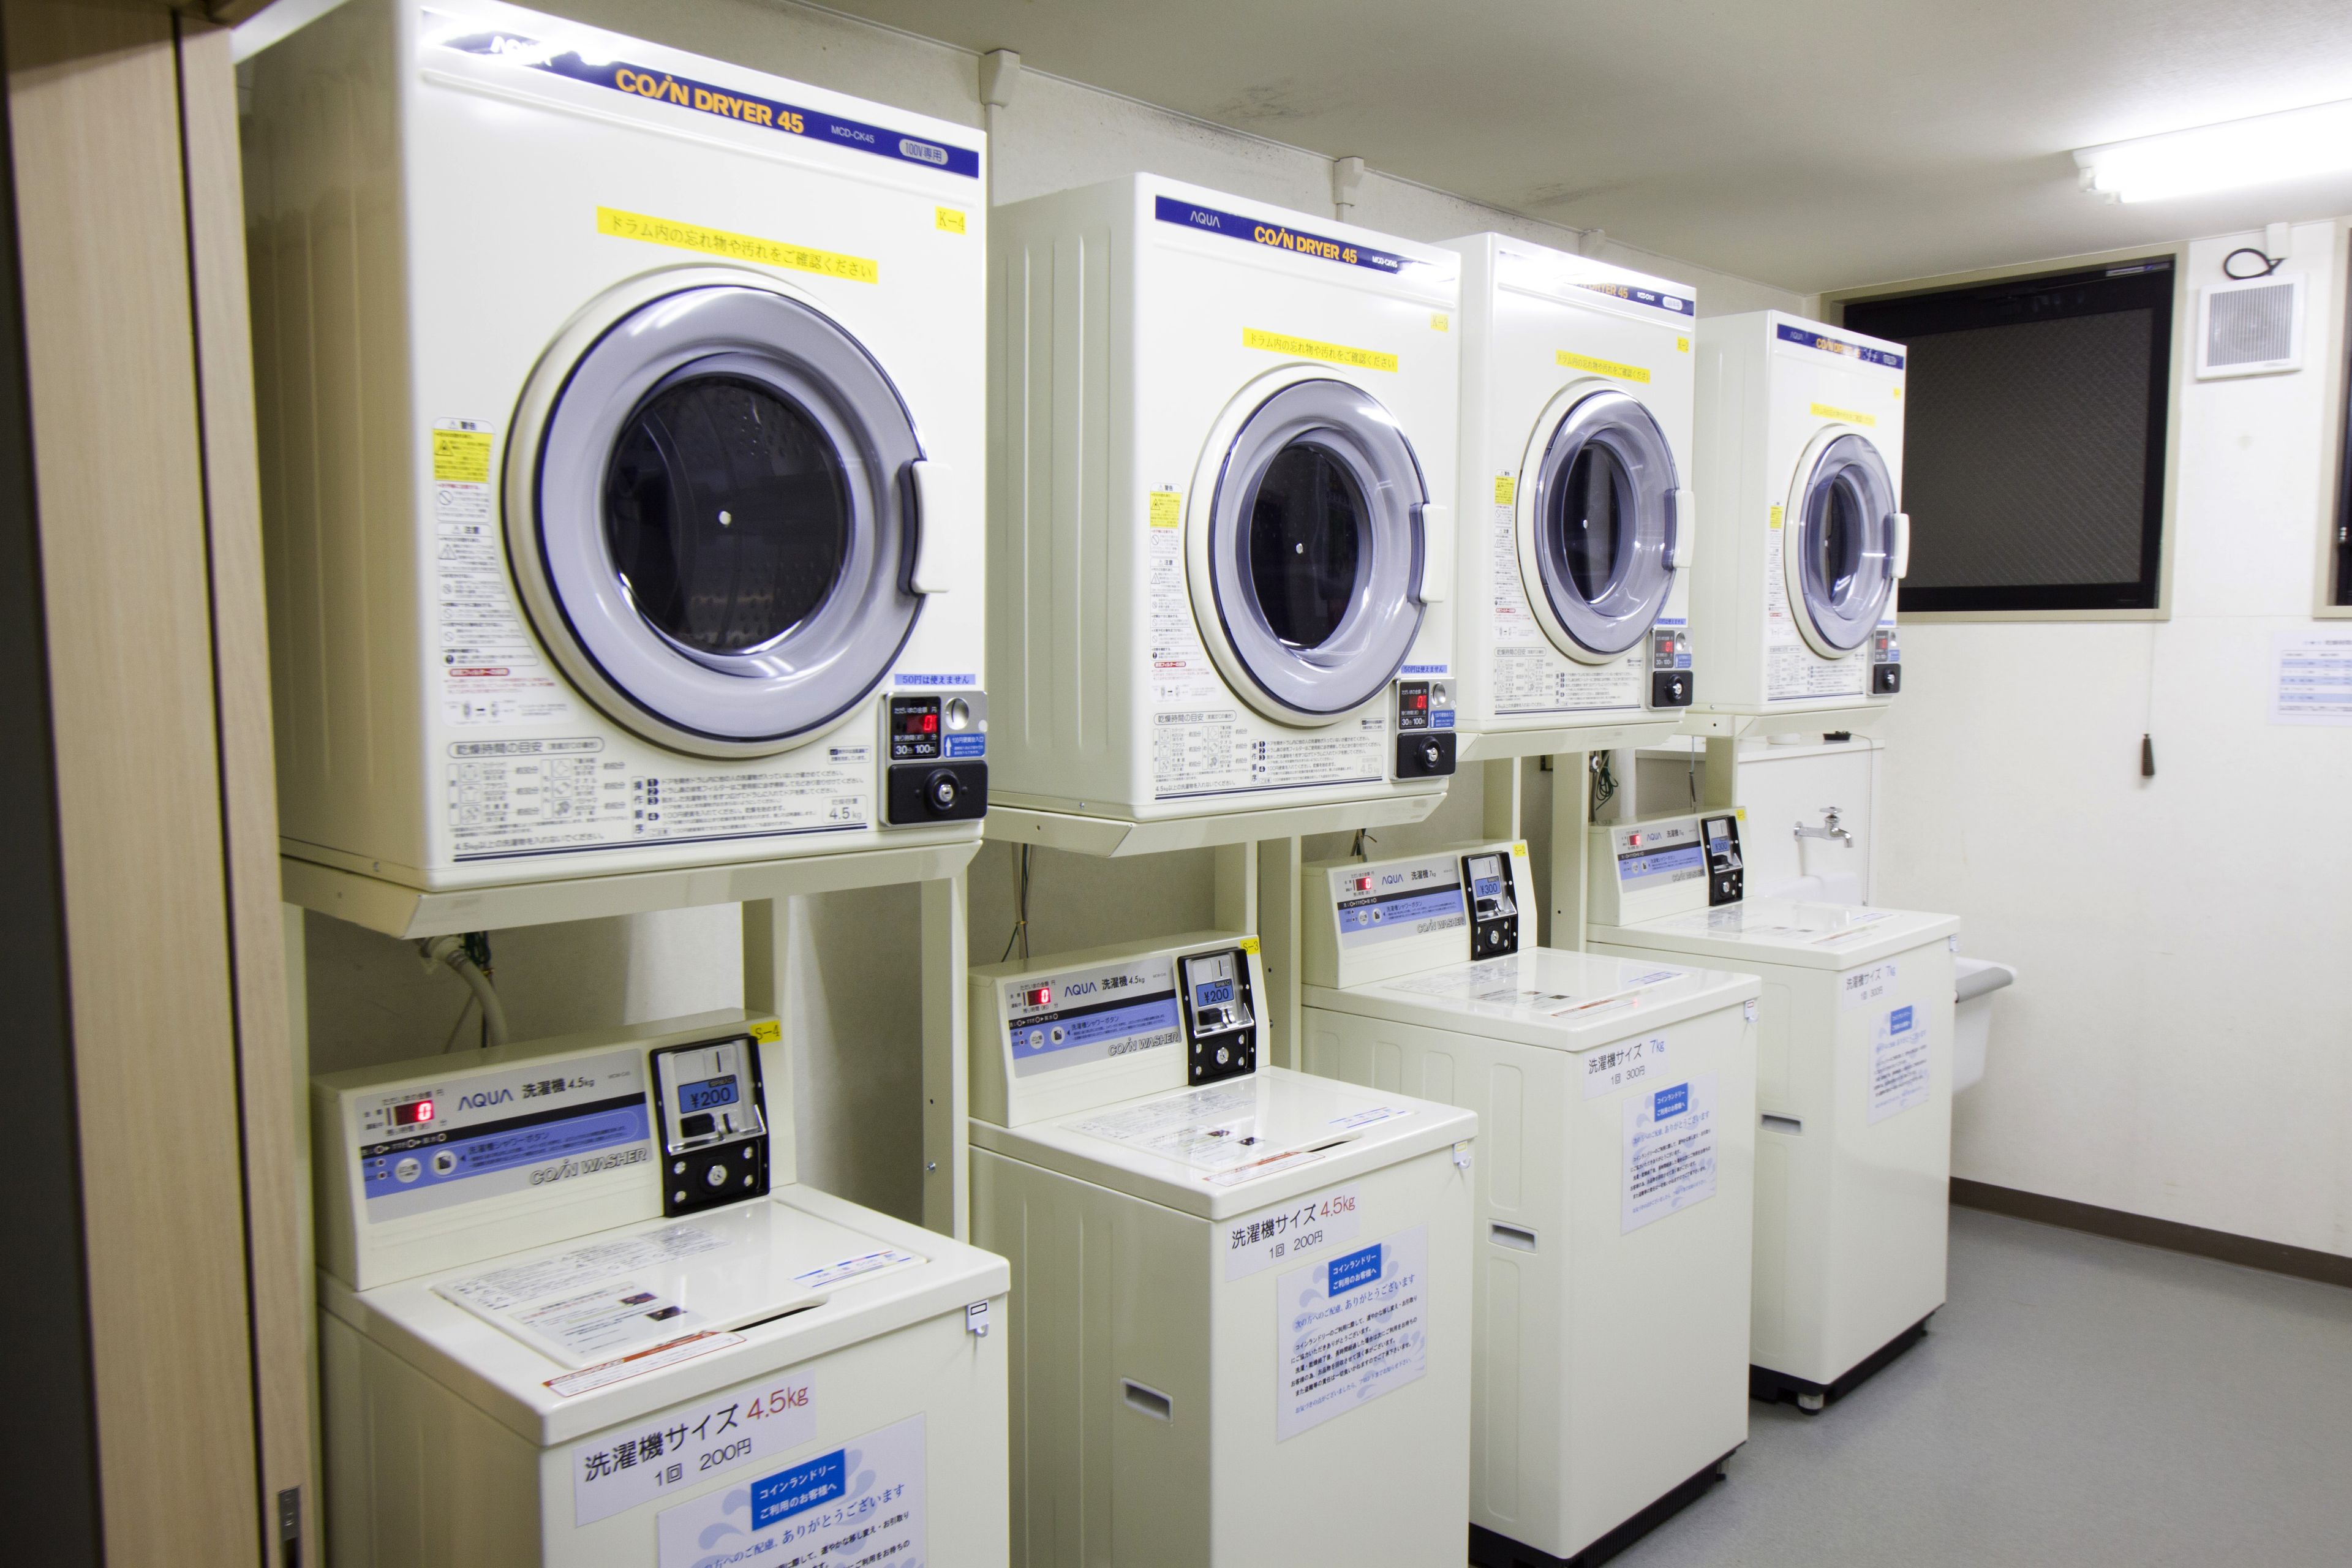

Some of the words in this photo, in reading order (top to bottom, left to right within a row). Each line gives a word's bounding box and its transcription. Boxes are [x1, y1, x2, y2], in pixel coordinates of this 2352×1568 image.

[694, 90, 772, 127] DRYER
[777, 111, 804, 134] 45
[831, 125, 875, 144] MCD-CK45
[905, 142, 942, 162] 100V専用
[612, 214, 872, 277] ドラム内の忘れ物や汚れをご確認ください
[1190, 211, 1220, 228] AQUA
[1297, 236, 1340, 260] DRYER
[1342, 248, 1357, 264] 45
[1618, 287, 1628, 298] 45
[1250, 334, 1395, 369] ドラム内の忘れ物や汚れをご確認ください
[903, 675, 970, 685] 50円は使えません
[1158, 714, 1204, 723] 乾燥時間の目安
[456, 742, 543, 755] 乾燥時間の目安
[1382, 874, 1403, 885] AQUA
[1411, 870, 1428, 880] 洗濯機
[1041, 989, 1049, 1003] 0
[1064, 982, 1097, 997] AQUA
[1102, 976, 1128, 990] 洗濯機
[1129, 975, 1145, 984] 4.5kg
[1204, 988, 1229, 1003] ¥200
[755, 1024, 780, 1040] S-4
[1138, 1032, 1178, 1050] WASHER
[1589, 1043, 1642, 1074] 洗濯機サイズ
[1650, 1039, 1665, 1054] 7kg
[1611, 1074, 1621, 1085] 1回
[1626, 1065, 1645, 1080] 300円
[457, 1088, 514, 1111] AQUA
[522, 1078, 566, 1099] 洗濯機
[568, 1077, 595, 1089] 4.5kg
[690, 1087, 731, 1108] ¥200
[418, 1102, 431, 1120] 0
[580, 1148, 647, 1175] WASHER
[1231, 1204, 1316, 1250] 洗濯機サイズ
[1320, 1195, 1355, 1218] 4.5kg
[1269, 1243, 1285, 1259] 1回
[1294, 1230, 1323, 1251] 200円
[1333, 1255, 1376, 1276] コインランドリー
[1333, 1268, 1377, 1290] ご利用のお客様へ
[1291, 1327, 1371, 1364] にご協力いただきありがとうございます。
[585, 1403, 739, 1482] 洗濯機サイズ
[746, 1386, 809, 1420] 4.5kg
[655, 1463, 683, 1487] 1回
[699, 1438, 752, 1471] 200円
[760, 1464, 837, 1500] コインランドリー
[760, 1483, 838, 1520] ご利用のお客様へ
